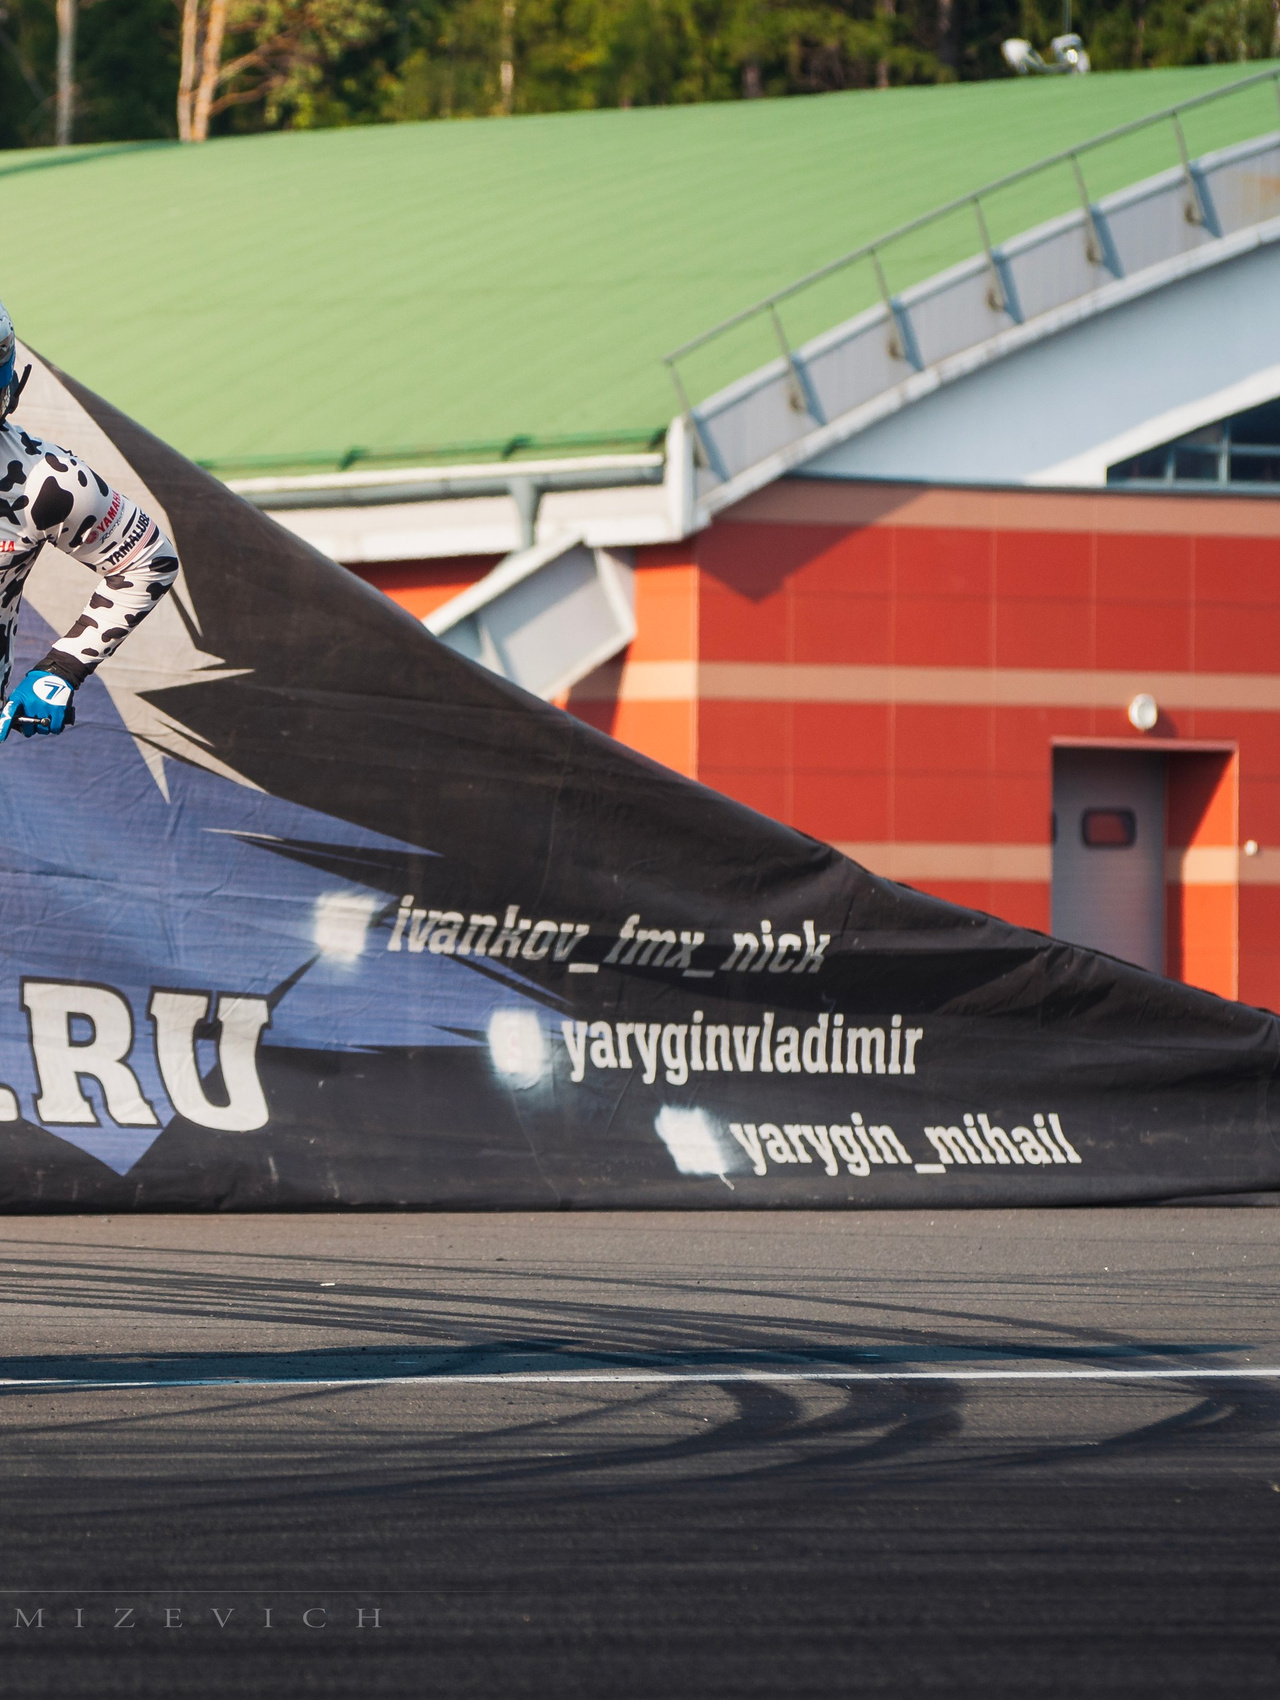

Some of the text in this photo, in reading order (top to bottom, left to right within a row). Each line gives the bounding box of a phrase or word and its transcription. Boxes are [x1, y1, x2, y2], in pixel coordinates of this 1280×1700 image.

[386, 895, 831, 977] ivankov_fmx_nick
[561, 1010, 924, 1086] yaryginvladimir
[730, 1111, 1083, 1177] yarygin_mihail
